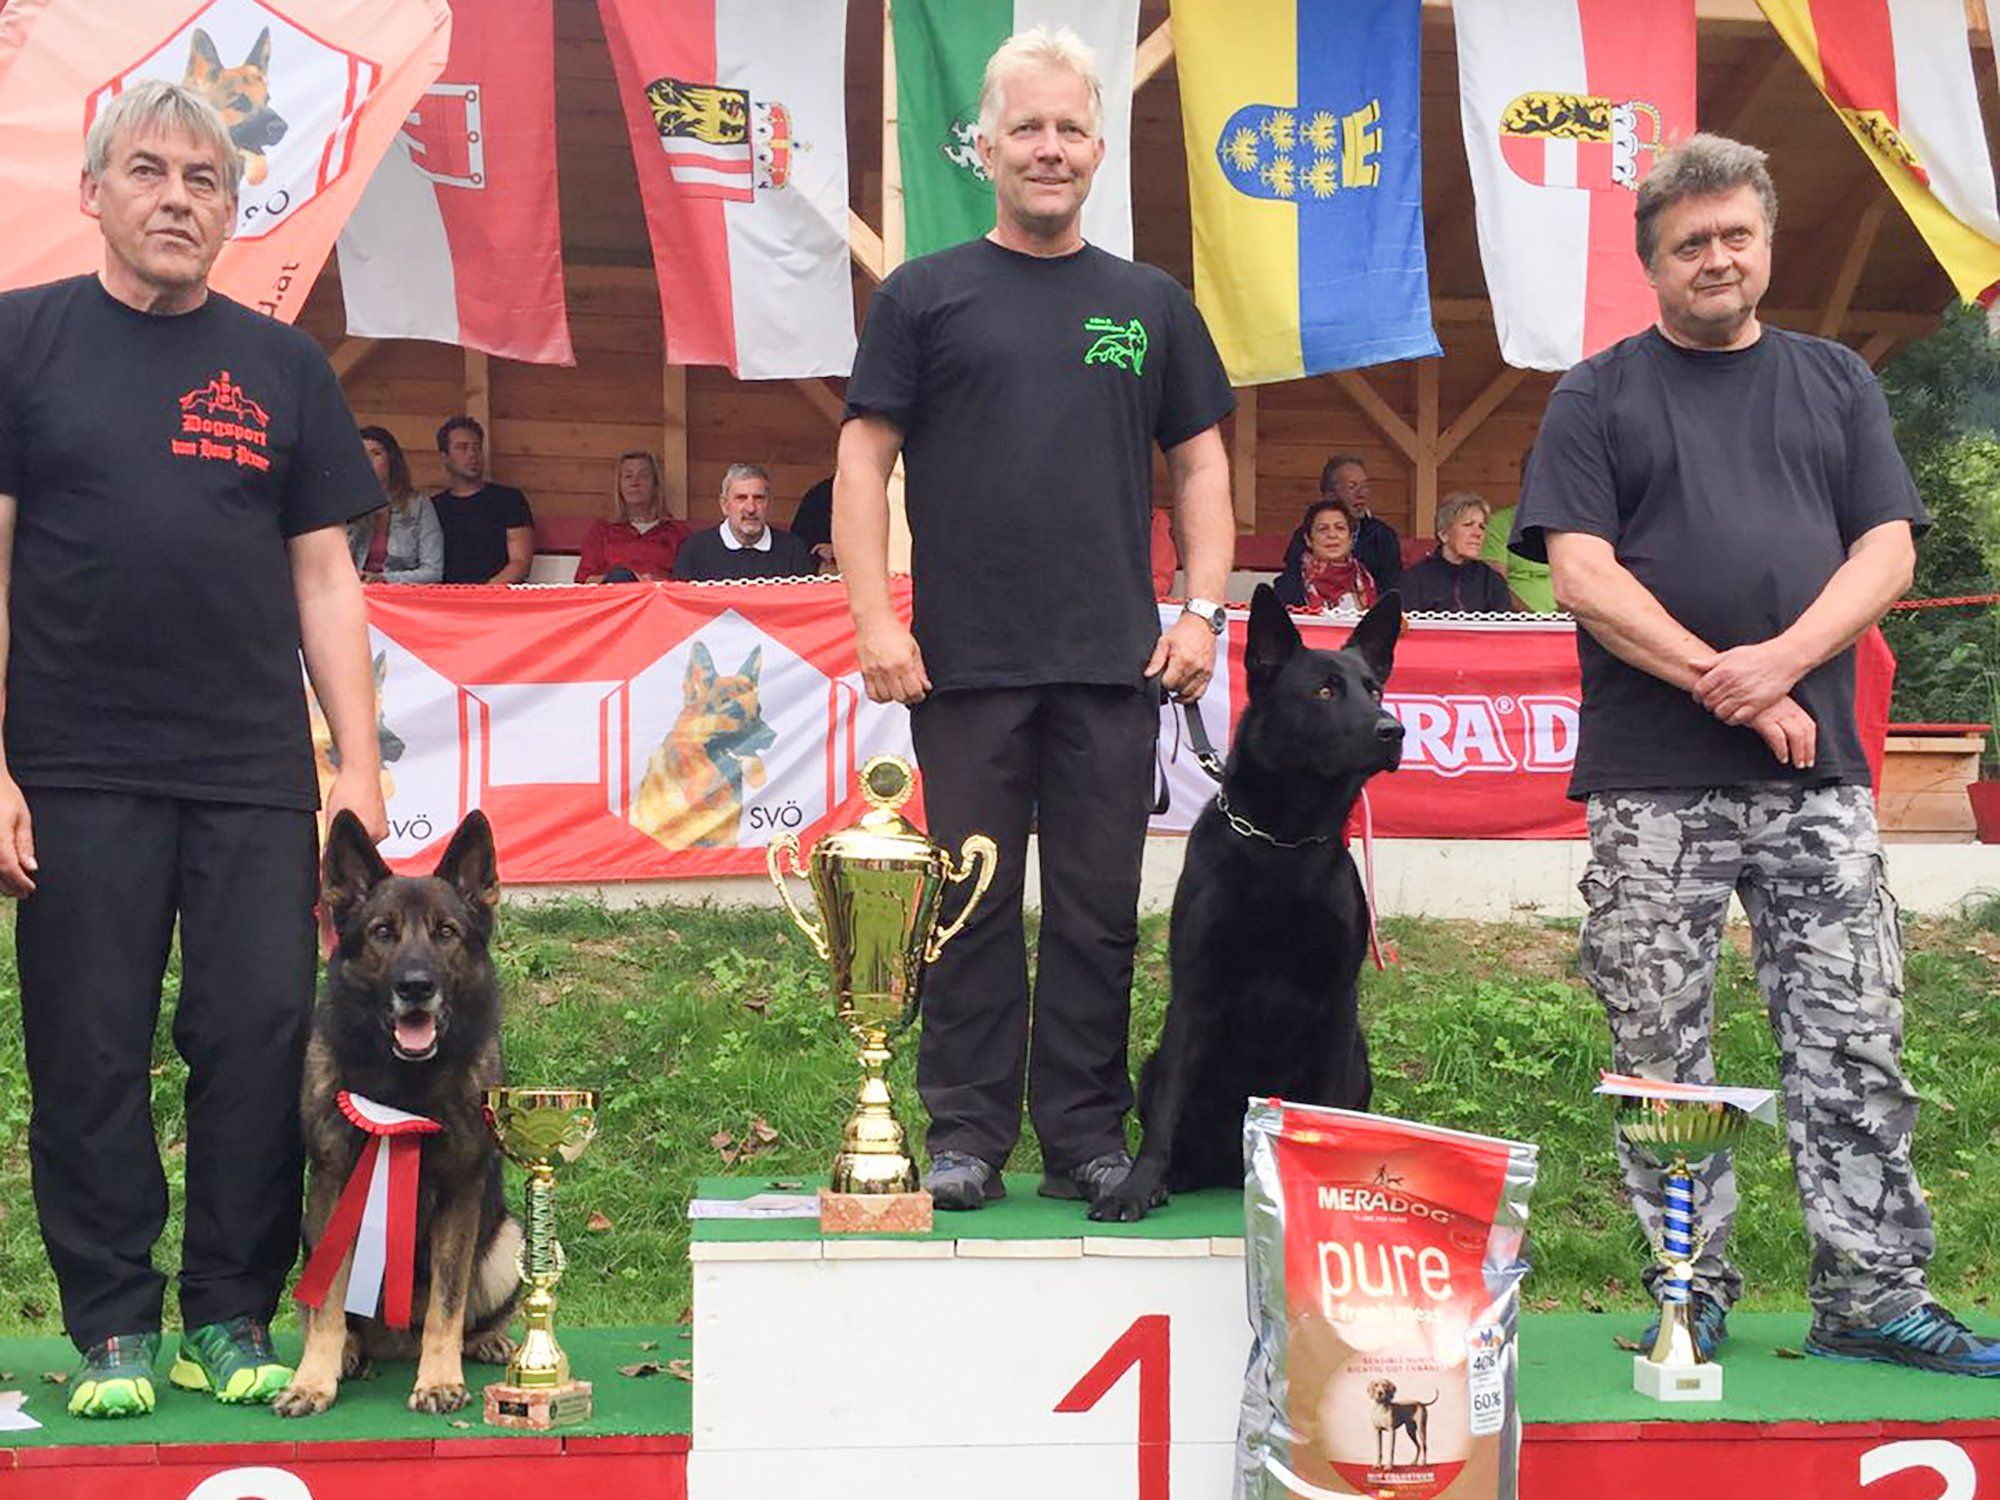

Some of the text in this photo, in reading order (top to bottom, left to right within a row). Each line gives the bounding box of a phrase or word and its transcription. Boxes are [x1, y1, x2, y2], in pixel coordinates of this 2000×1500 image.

[182, 414, 267, 446] Dogsport
[387, 814, 432, 840] VÖ
[750, 800, 802, 829] SVÖ
[1317, 1241, 1453, 1319] pure
[1053, 1314, 1170, 1500] 1
[1474, 1391, 1501, 1411] 60%
